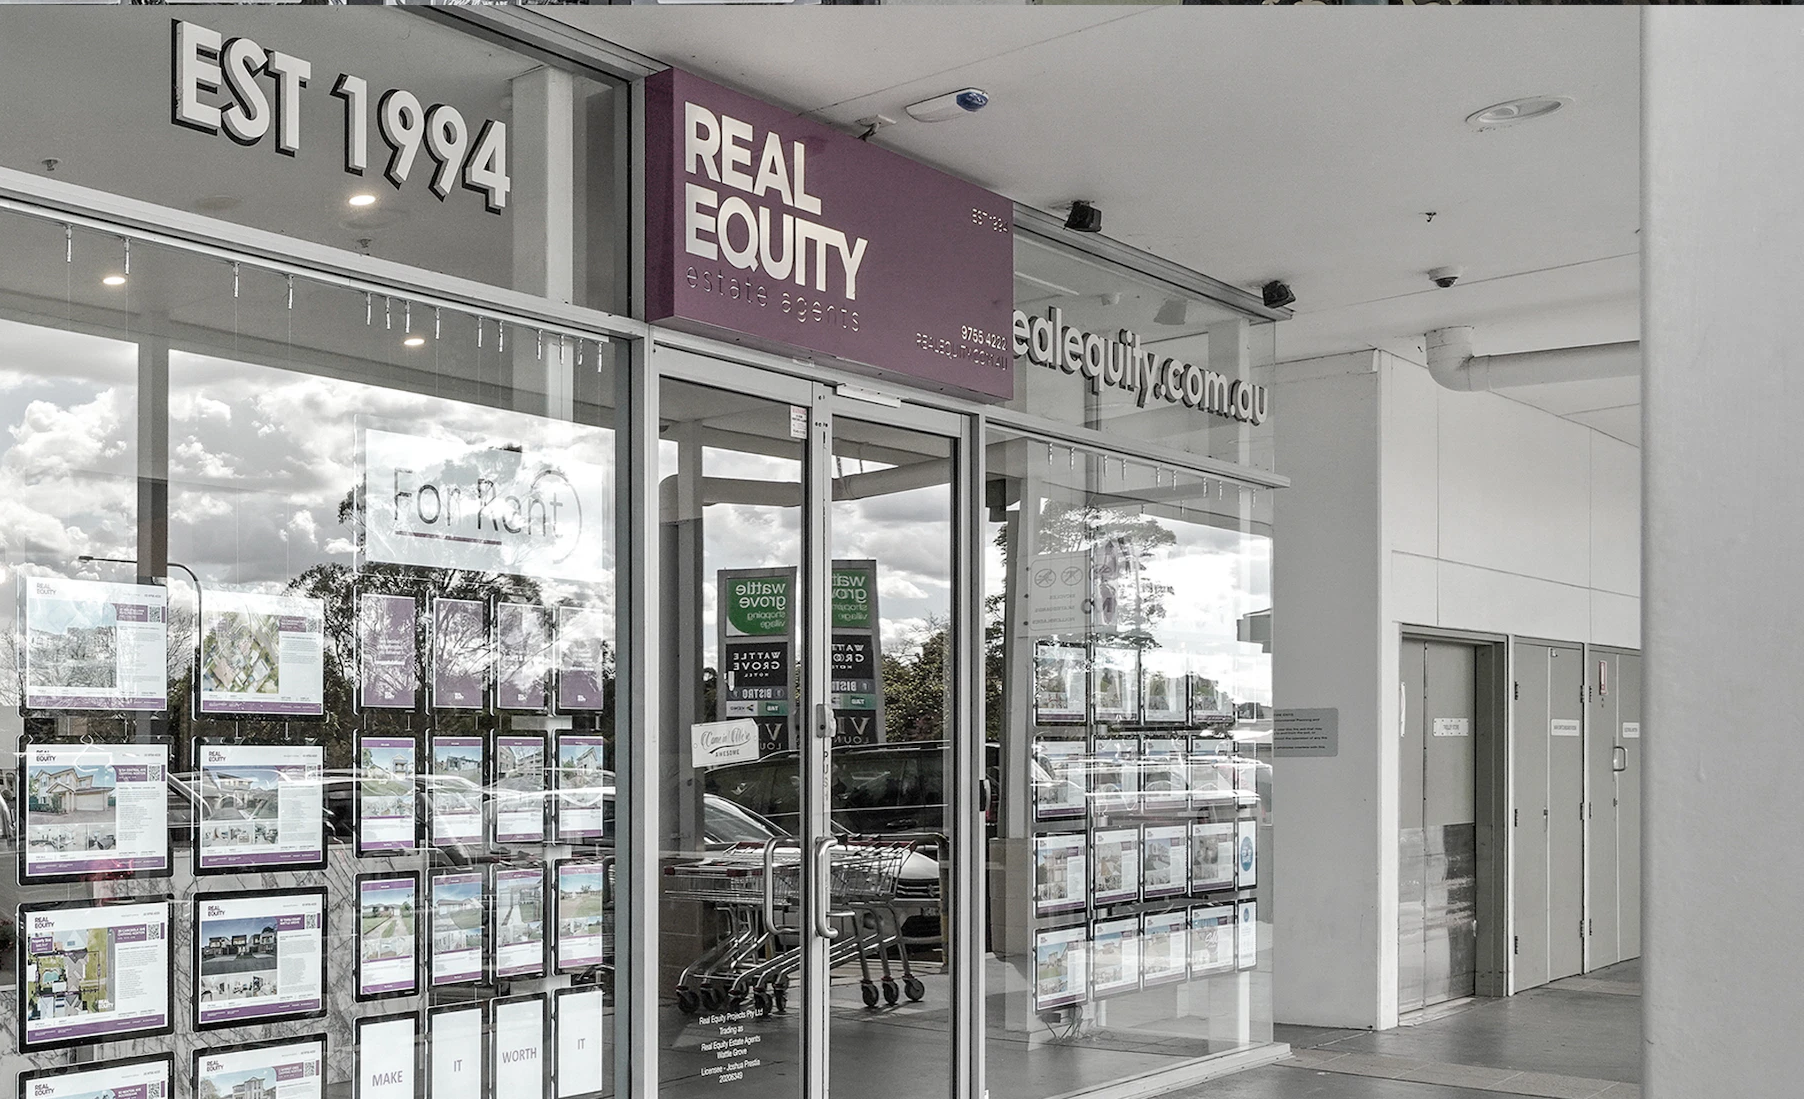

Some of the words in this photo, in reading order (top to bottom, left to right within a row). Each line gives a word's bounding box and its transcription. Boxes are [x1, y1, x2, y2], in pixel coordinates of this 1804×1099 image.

[174, 20, 311, 154] EST
[332, 74, 510, 213] 1994
[685, 101, 821, 215] REAL
[686, 182, 868, 300] EQUITY
[687, 266, 767, 307] estate
[781, 292, 860, 333] agents
[961, 325, 984, 345] 9755
[986, 333, 1007, 350] 4222
[395, 468, 461, 526] For
[699, 1016, 710, 1024] Real
[577, 1038, 586, 1050] IT
[701, 1042, 712, 1051] Real
[733, 1048, 747, 1056] Grove
[502, 1047, 537, 1064] WORTH
[453, 1059, 463, 1072] IT
[372, 1070, 403, 1087] MAKE
